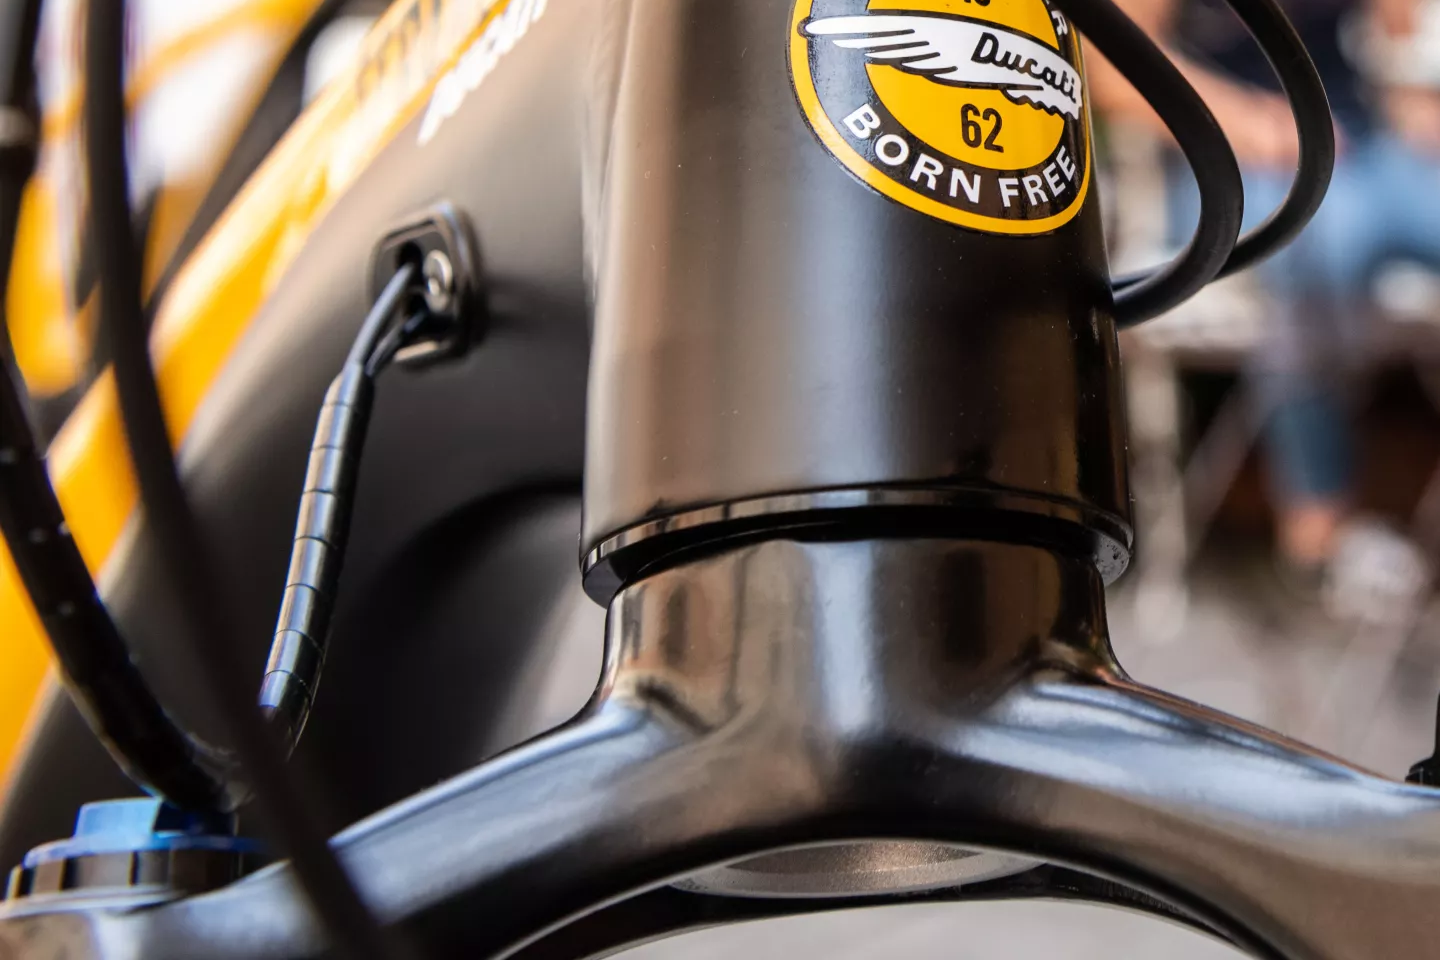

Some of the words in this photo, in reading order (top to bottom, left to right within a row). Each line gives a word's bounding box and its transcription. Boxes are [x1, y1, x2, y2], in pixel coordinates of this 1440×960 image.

[970, 32, 1077, 105] Ducati
[842, 103, 982, 204] BORN
[998, 145, 1076, 208] FREE
[960, 103, 1004, 154] 62
